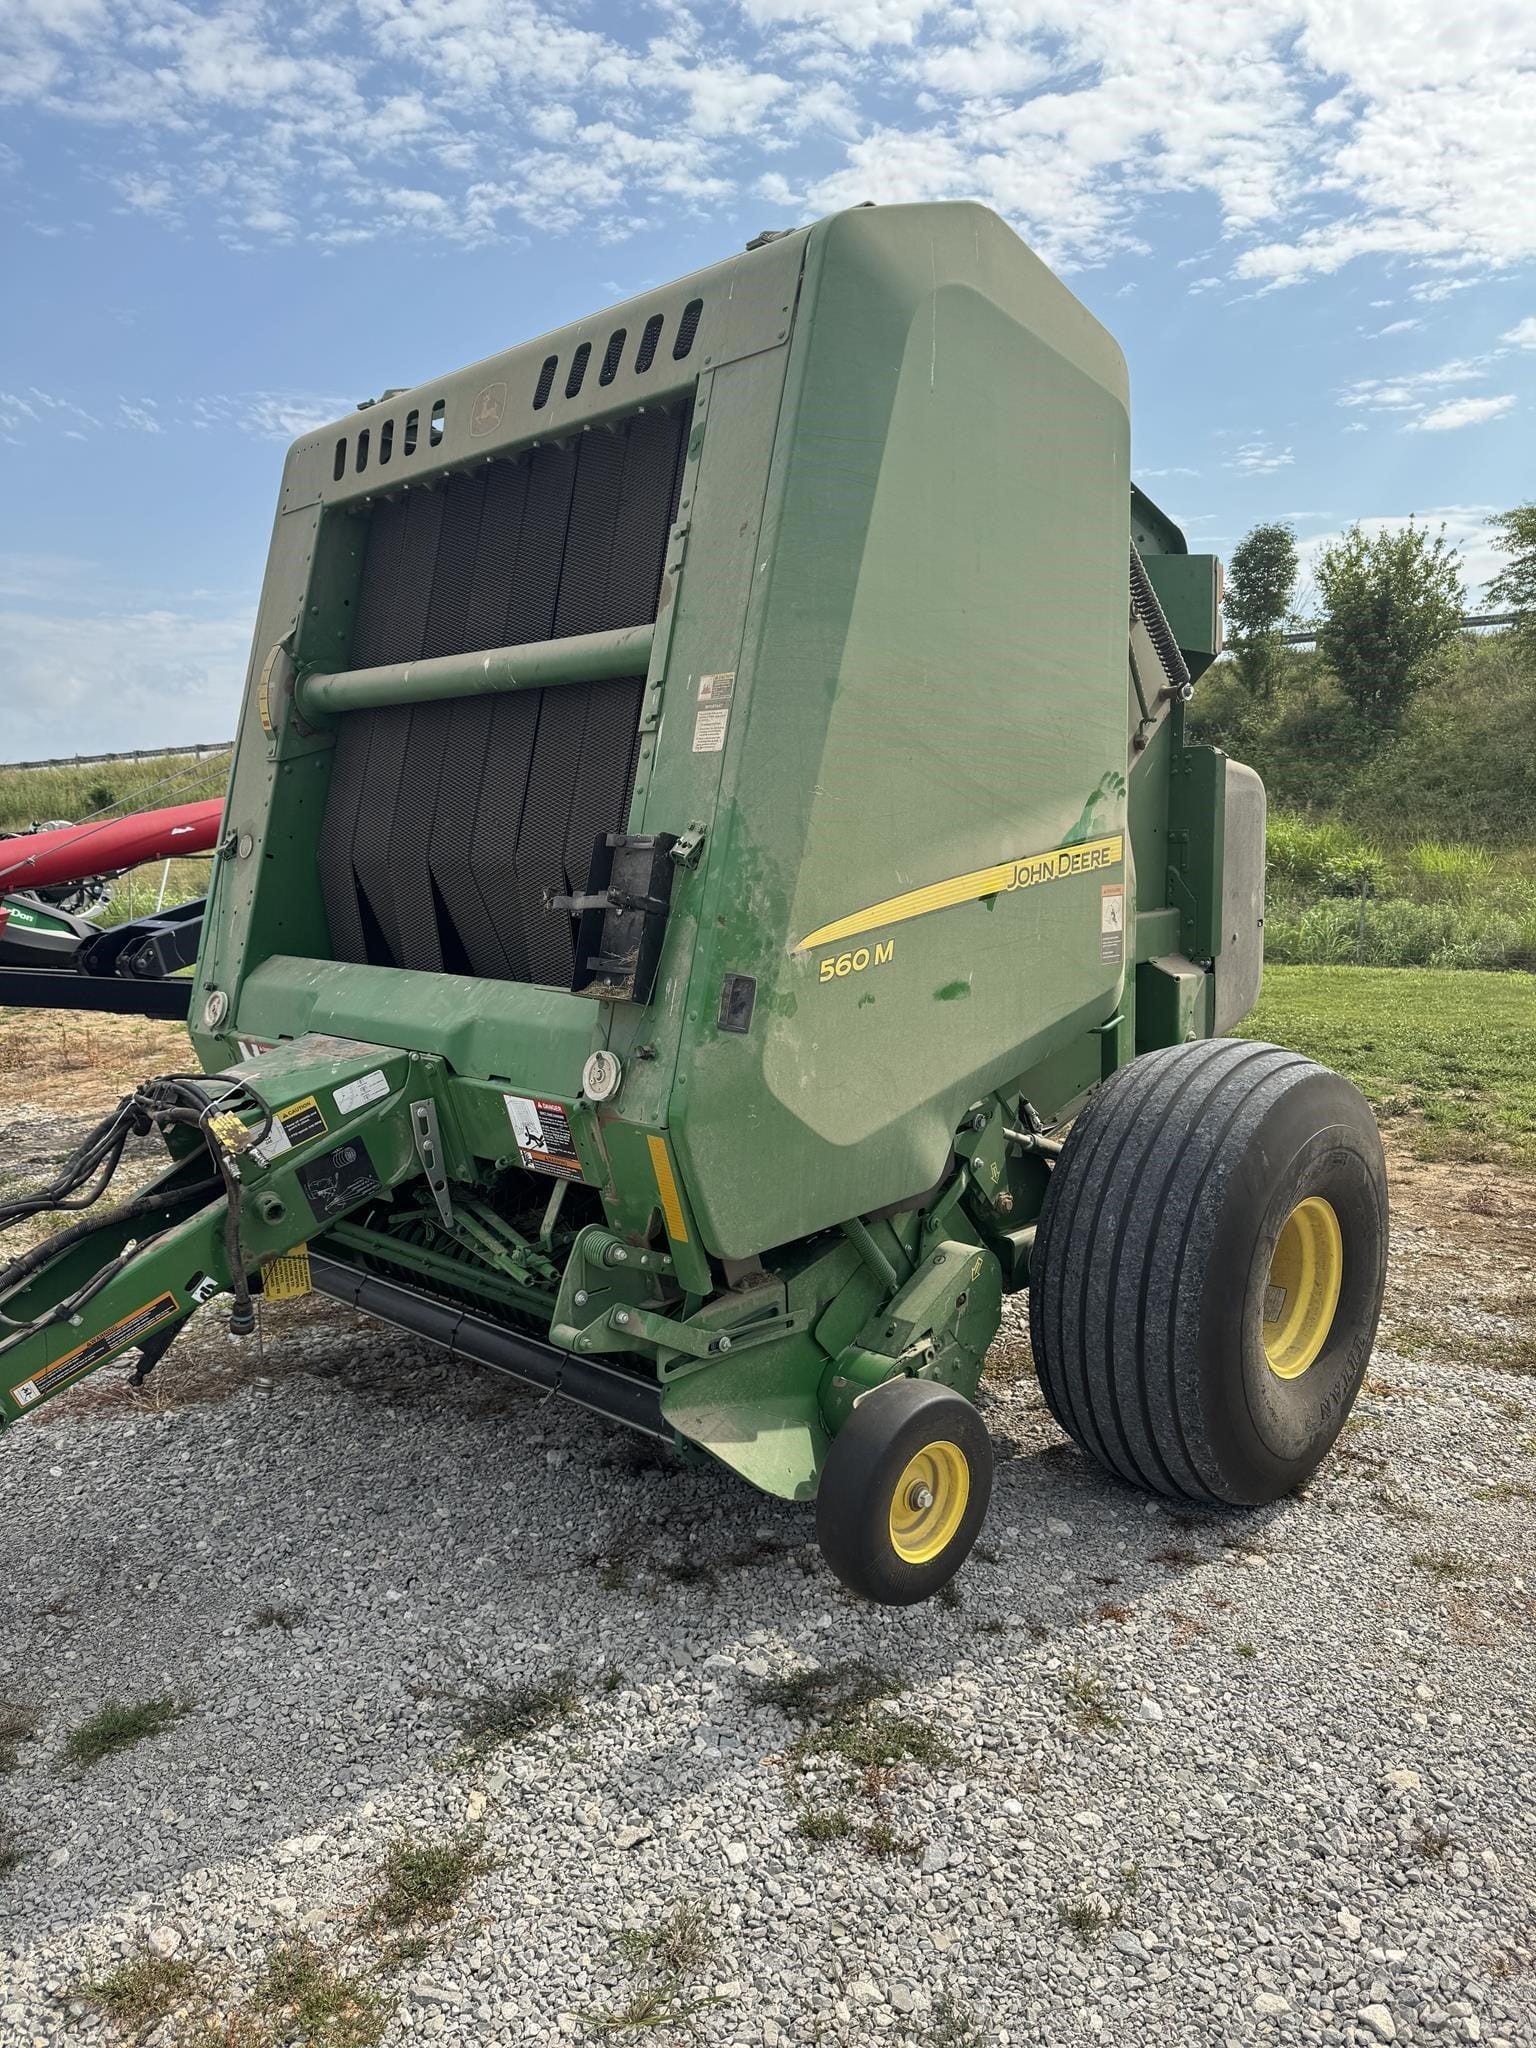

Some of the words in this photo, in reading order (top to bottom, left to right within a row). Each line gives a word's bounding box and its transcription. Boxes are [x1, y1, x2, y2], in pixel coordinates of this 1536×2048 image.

[1008, 860, 1054, 888] JOHN
[1058, 847, 1111, 875] DEERE
[819, 947, 870, 983] 560
[874, 938, 895, 966] M
[287, 1100, 311, 1116] CAUTION
[542, 1102, 562, 1112] DANGER
[90, 1325, 118, 1344] WARNING
